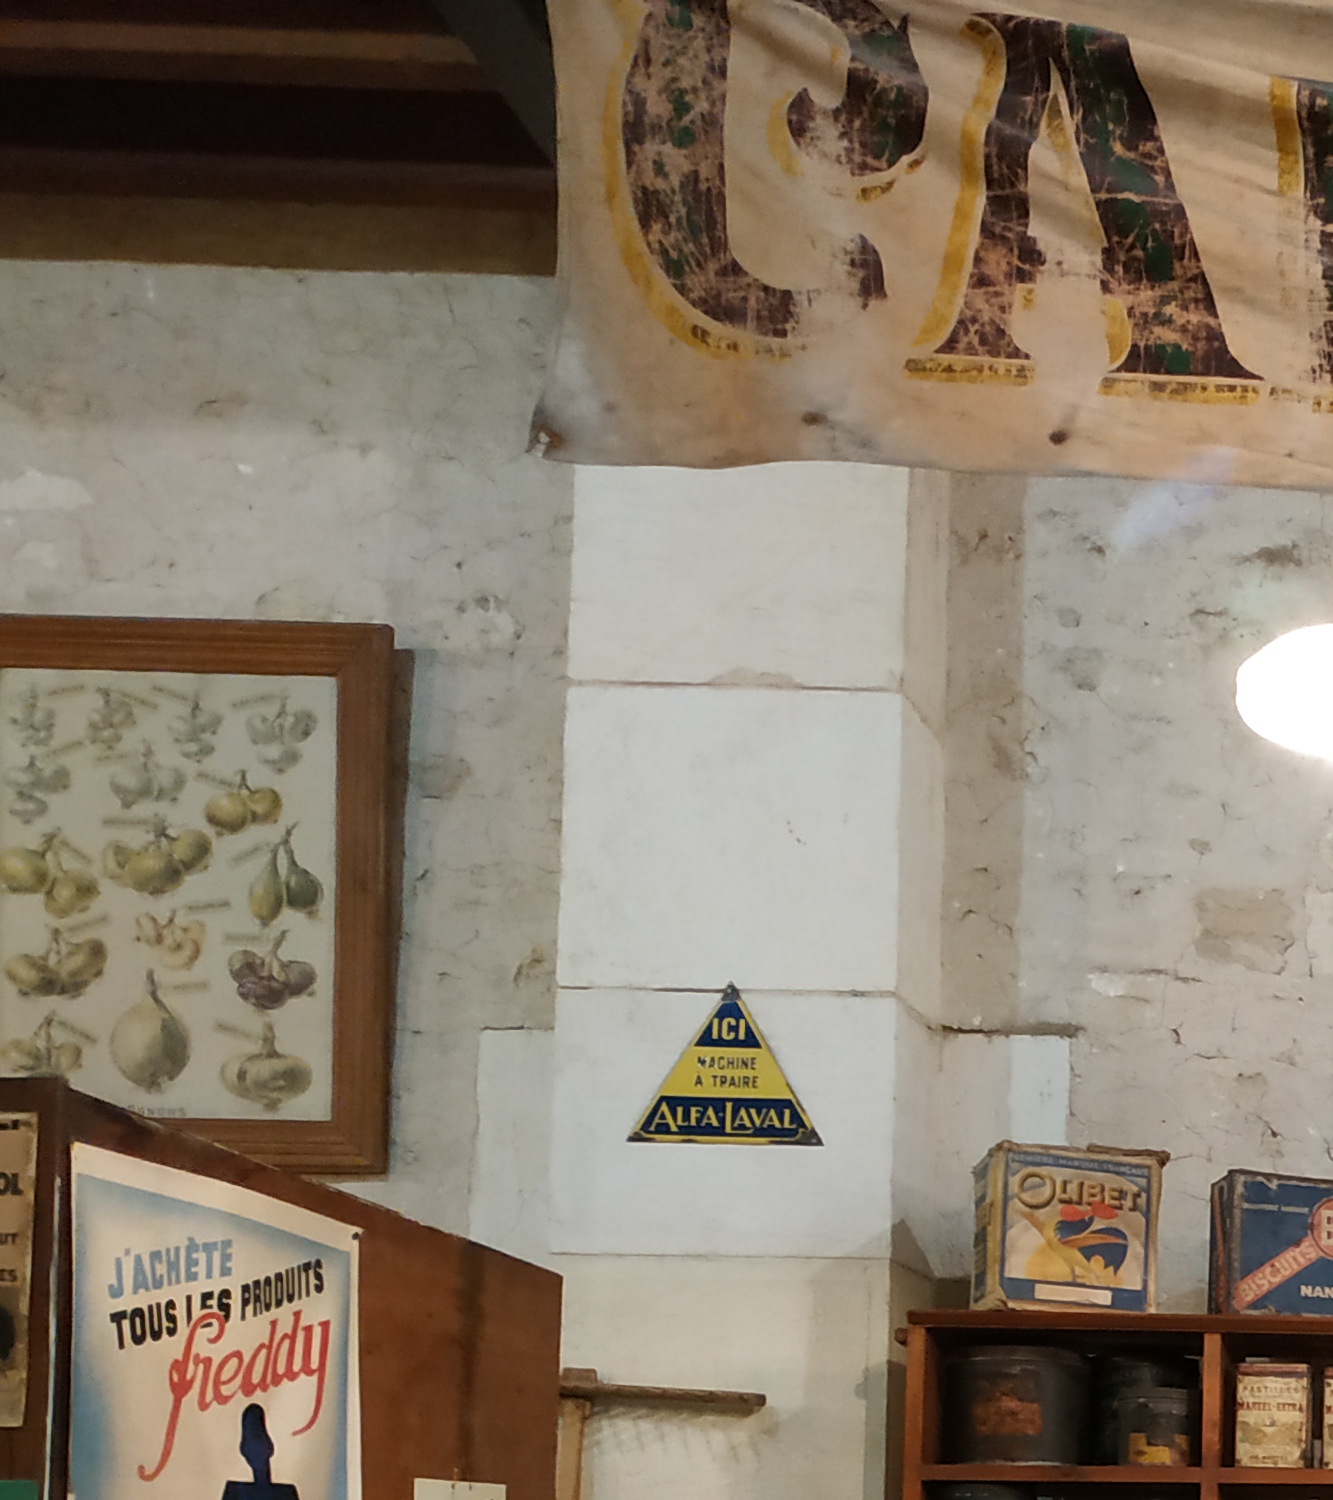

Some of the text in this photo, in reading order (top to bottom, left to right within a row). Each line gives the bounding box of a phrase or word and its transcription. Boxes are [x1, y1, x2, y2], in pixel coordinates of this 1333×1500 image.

[711, 1016, 747, 1041] ICI
[697, 1056, 758, 1071] MACHINE
[711, 1074, 760, 1089] TRAIRE
[1016, 1170, 1144, 1212] OLIBET
[106, 1236, 234, 1300] J'ACHÈTE
[1237, 1241, 1319, 1302] BISCUITS
[109, 1257, 326, 1351] TOUS LES PRODUITS
